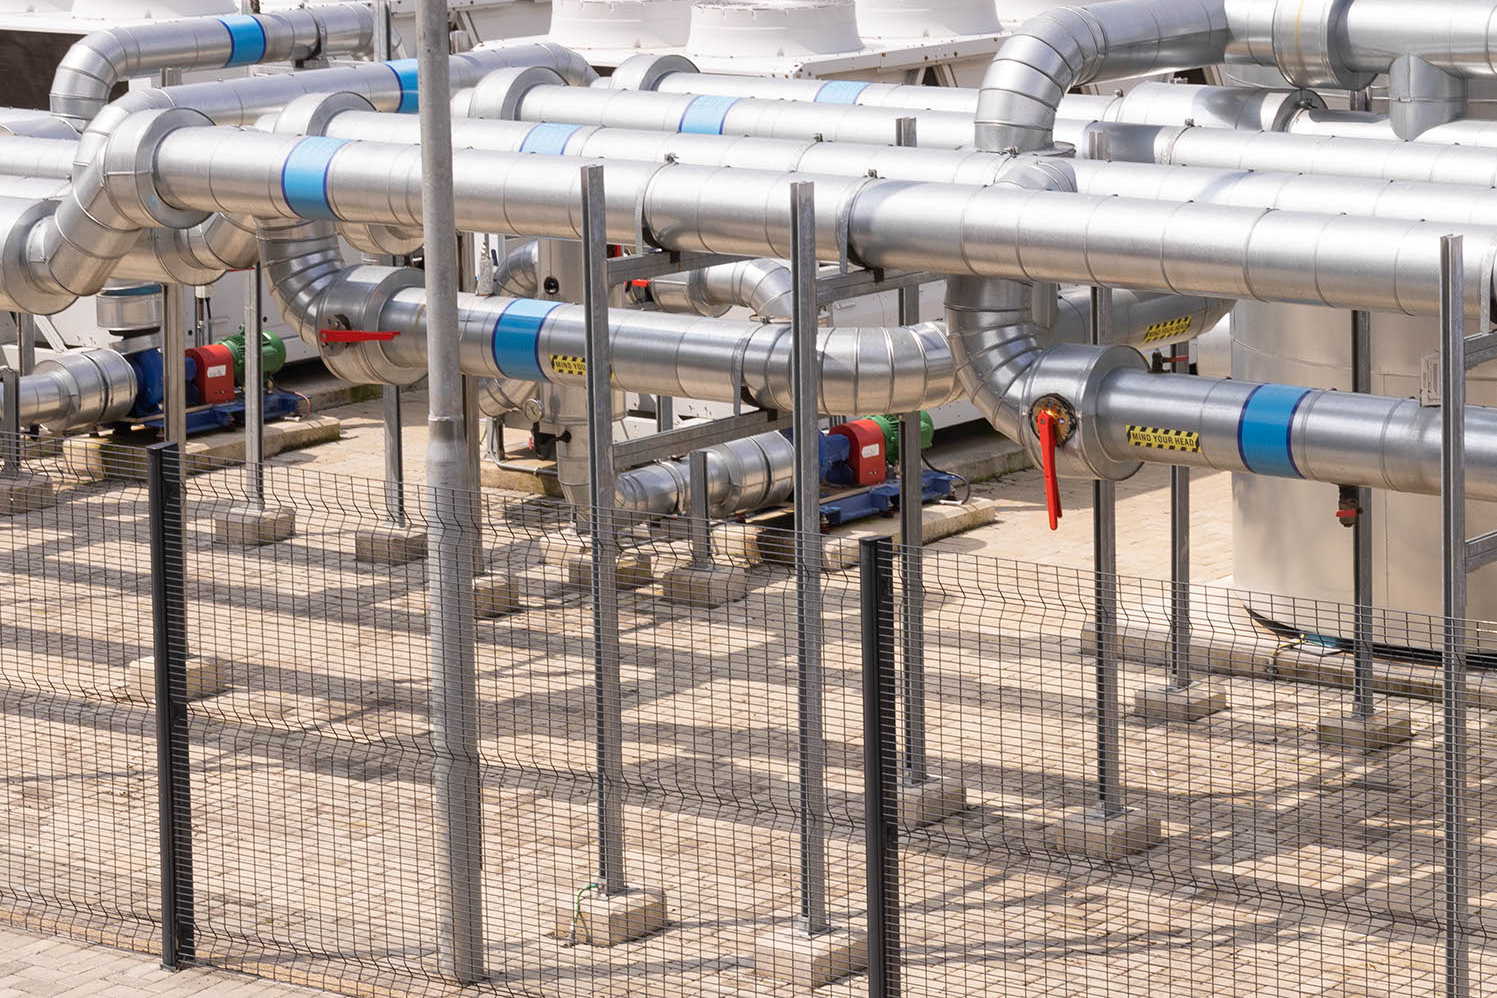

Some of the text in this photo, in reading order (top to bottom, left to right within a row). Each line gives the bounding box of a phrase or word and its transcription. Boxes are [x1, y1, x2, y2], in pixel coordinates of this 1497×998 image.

[556, 361, 572, 369] MIND
[1132, 433, 1194, 446] MIND YOUR HEAD
